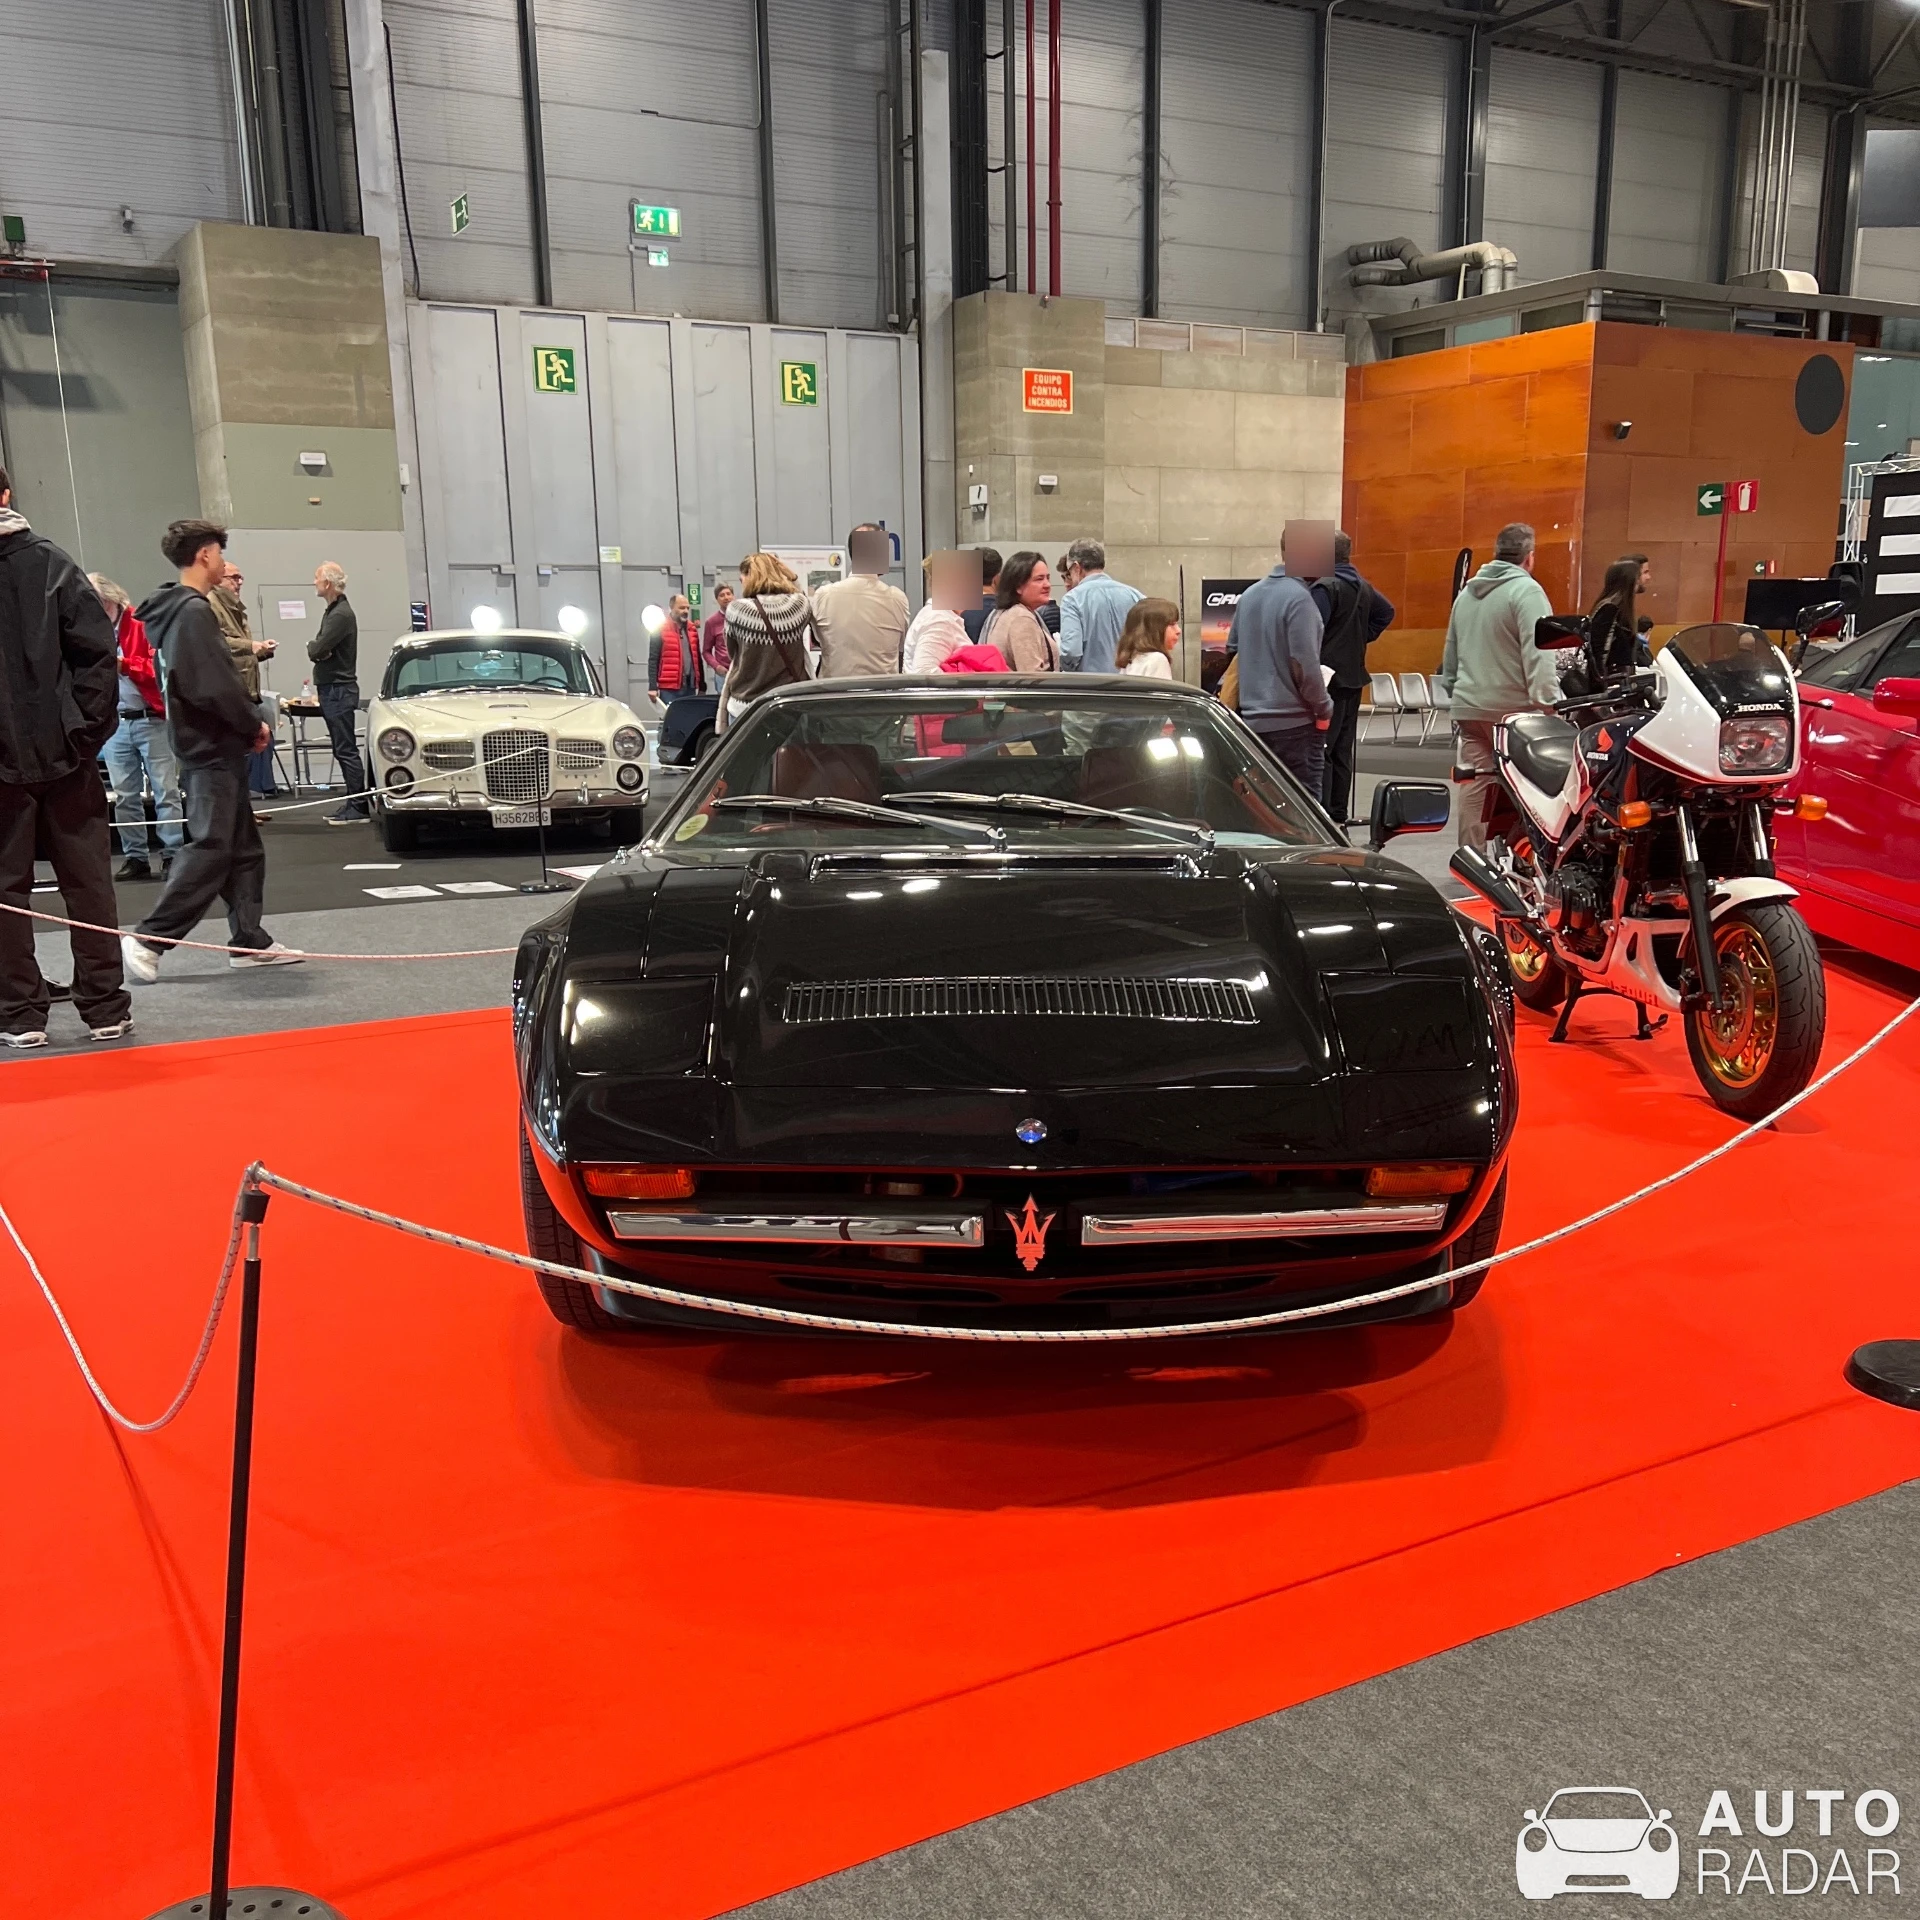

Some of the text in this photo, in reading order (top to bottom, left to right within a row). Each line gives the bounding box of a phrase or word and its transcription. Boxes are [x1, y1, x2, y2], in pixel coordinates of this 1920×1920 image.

[1033, 373, 1062, 385] EQUIPO
[1031, 385, 1063, 397] CONTRA
[1028, 396, 1068, 409] INCENDIOS
[1738, 703, 1785, 713] HONDA
[494, 810, 550, 825] H3562BBG
